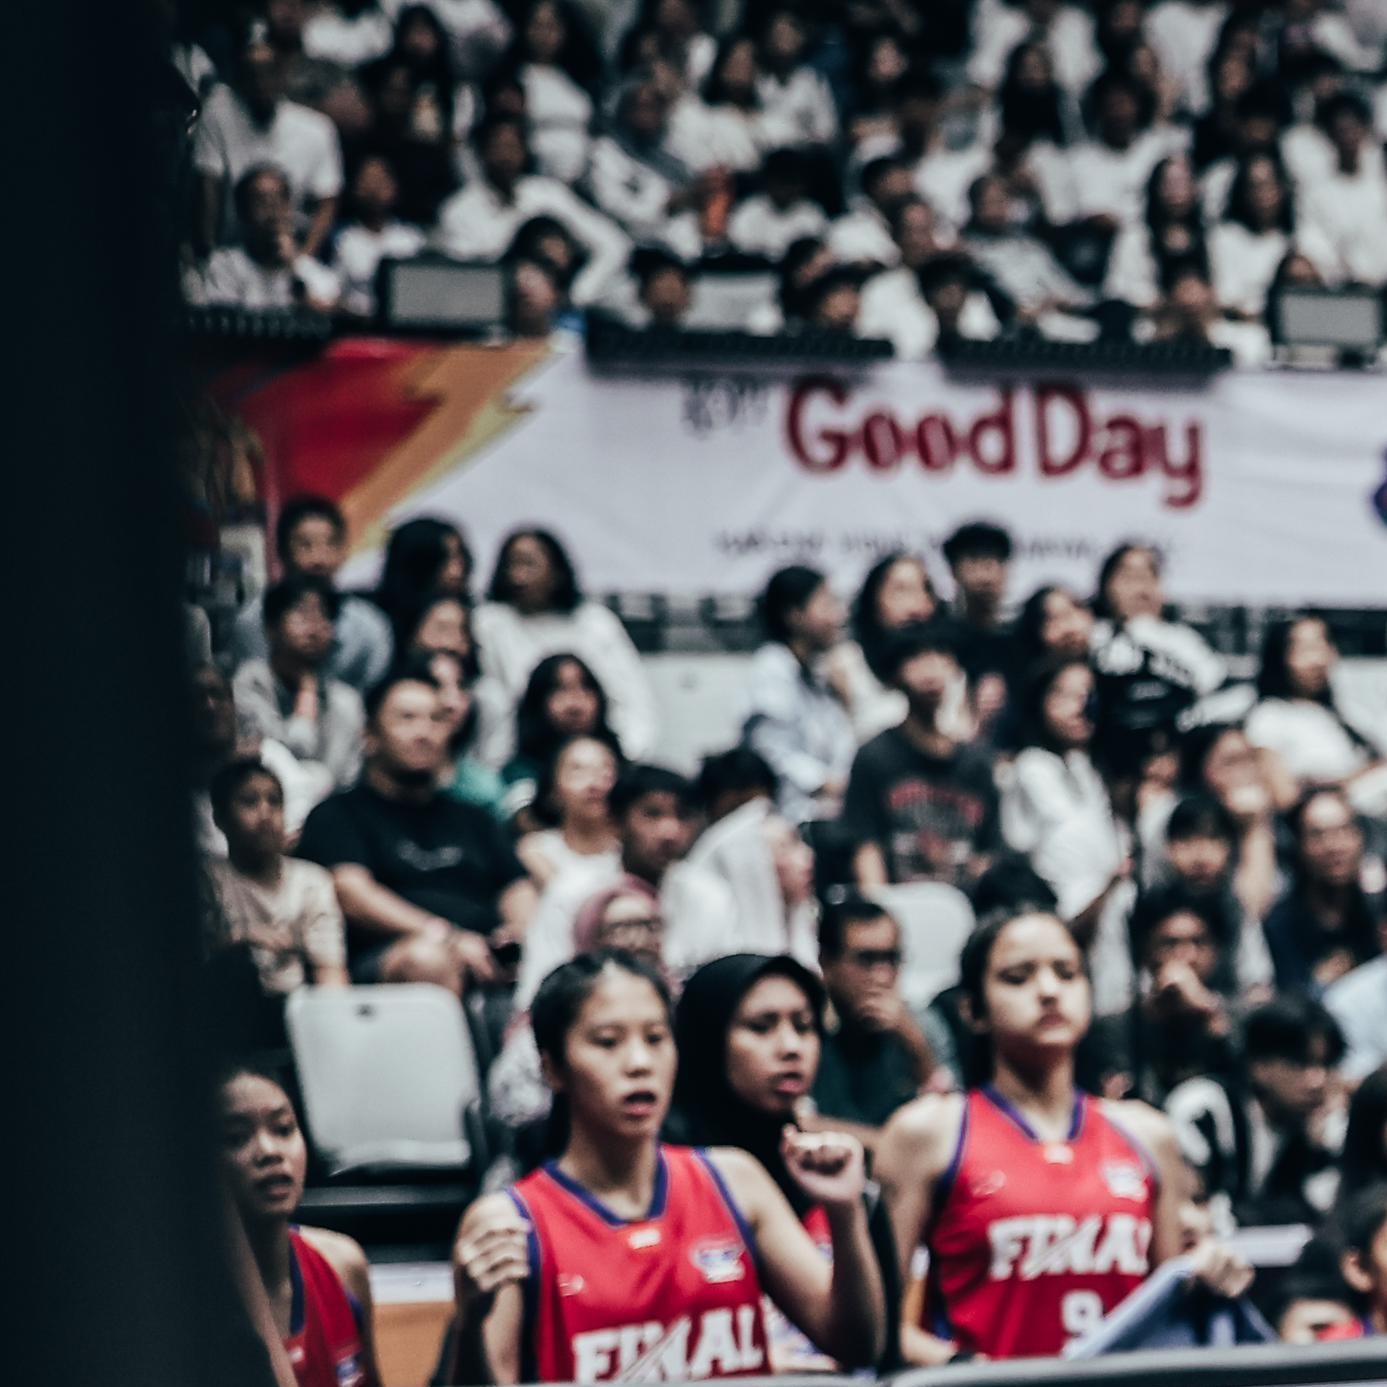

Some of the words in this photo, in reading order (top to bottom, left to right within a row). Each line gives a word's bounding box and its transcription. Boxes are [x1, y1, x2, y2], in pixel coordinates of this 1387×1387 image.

[783, 371, 1020, 476] Good
[1035, 377, 1207, 508] Day
[572, 1303, 764, 1384] FINAL
